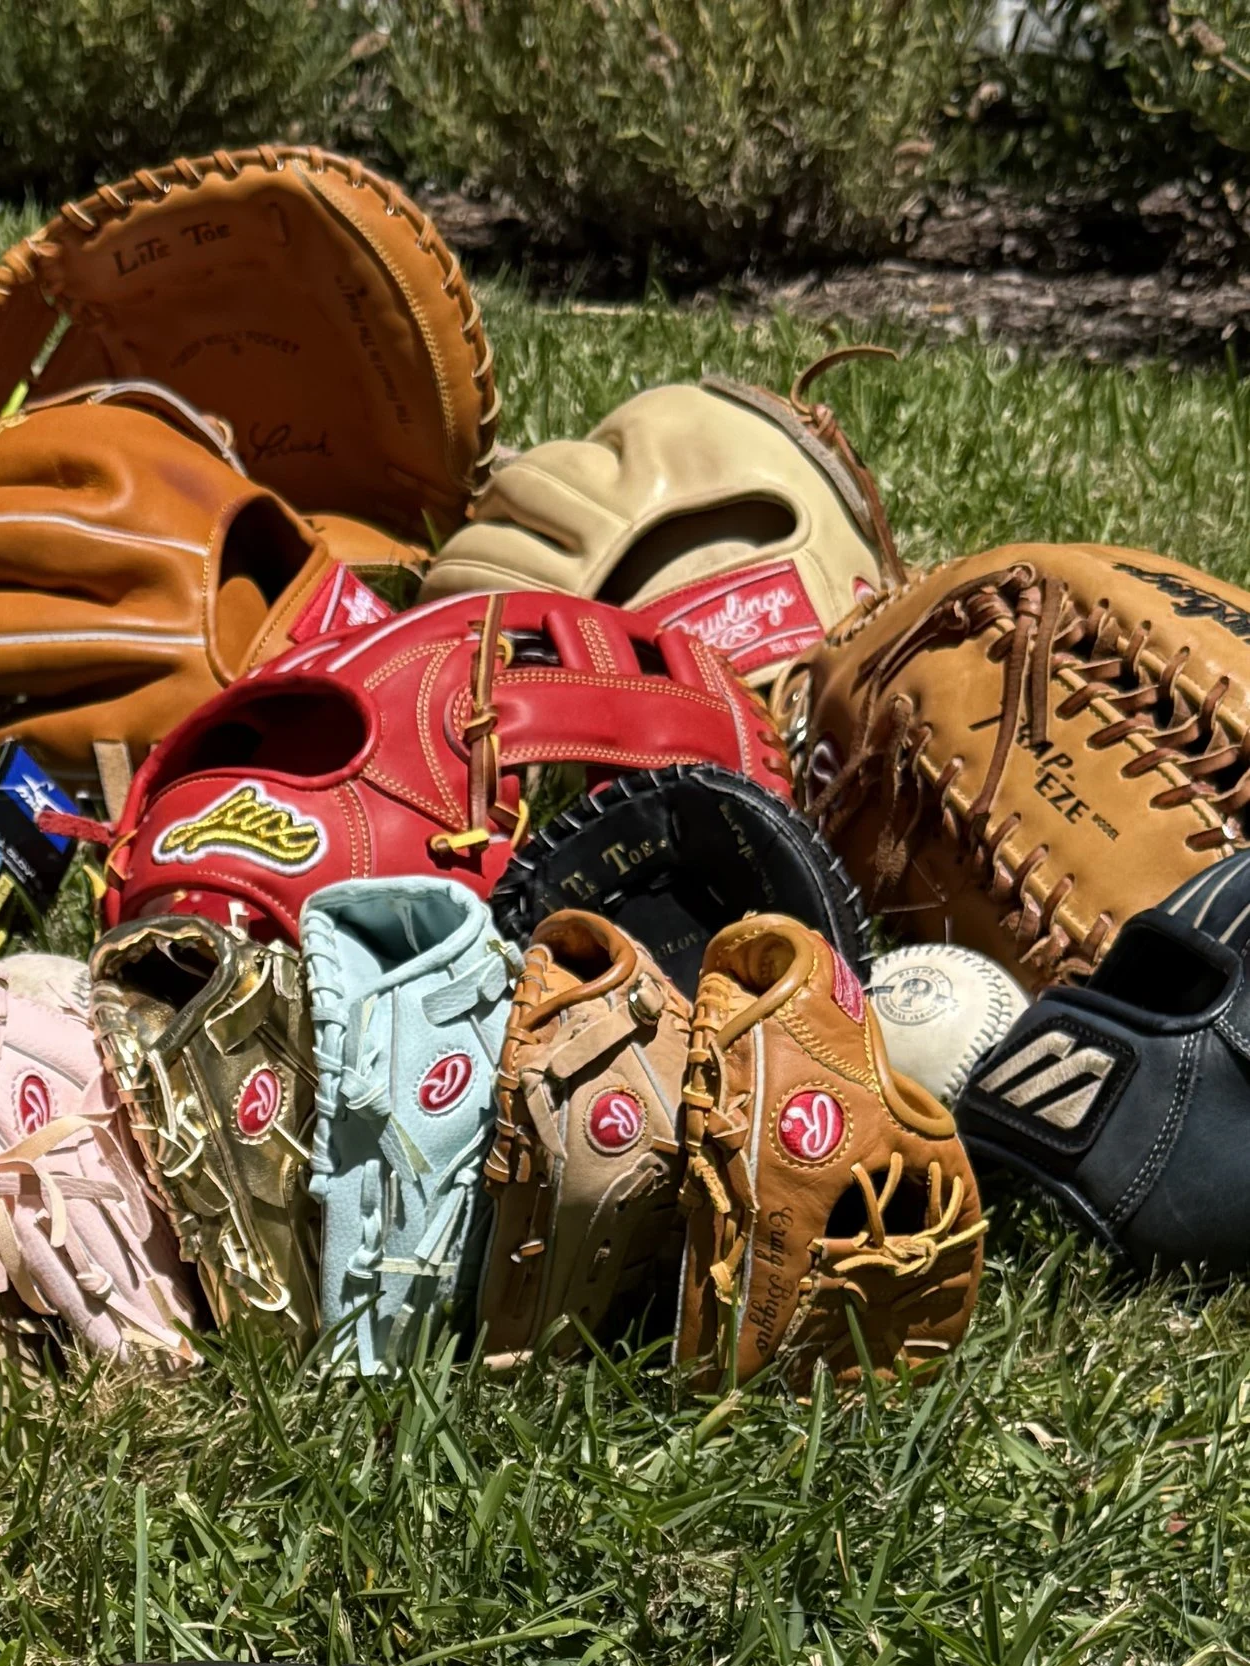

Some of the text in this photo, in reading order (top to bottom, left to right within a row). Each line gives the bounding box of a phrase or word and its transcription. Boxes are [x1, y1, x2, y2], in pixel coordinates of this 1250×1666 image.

[1034, 772, 1090, 824] EZE
[748, 1207, 794, 1357] Craig Biggio
